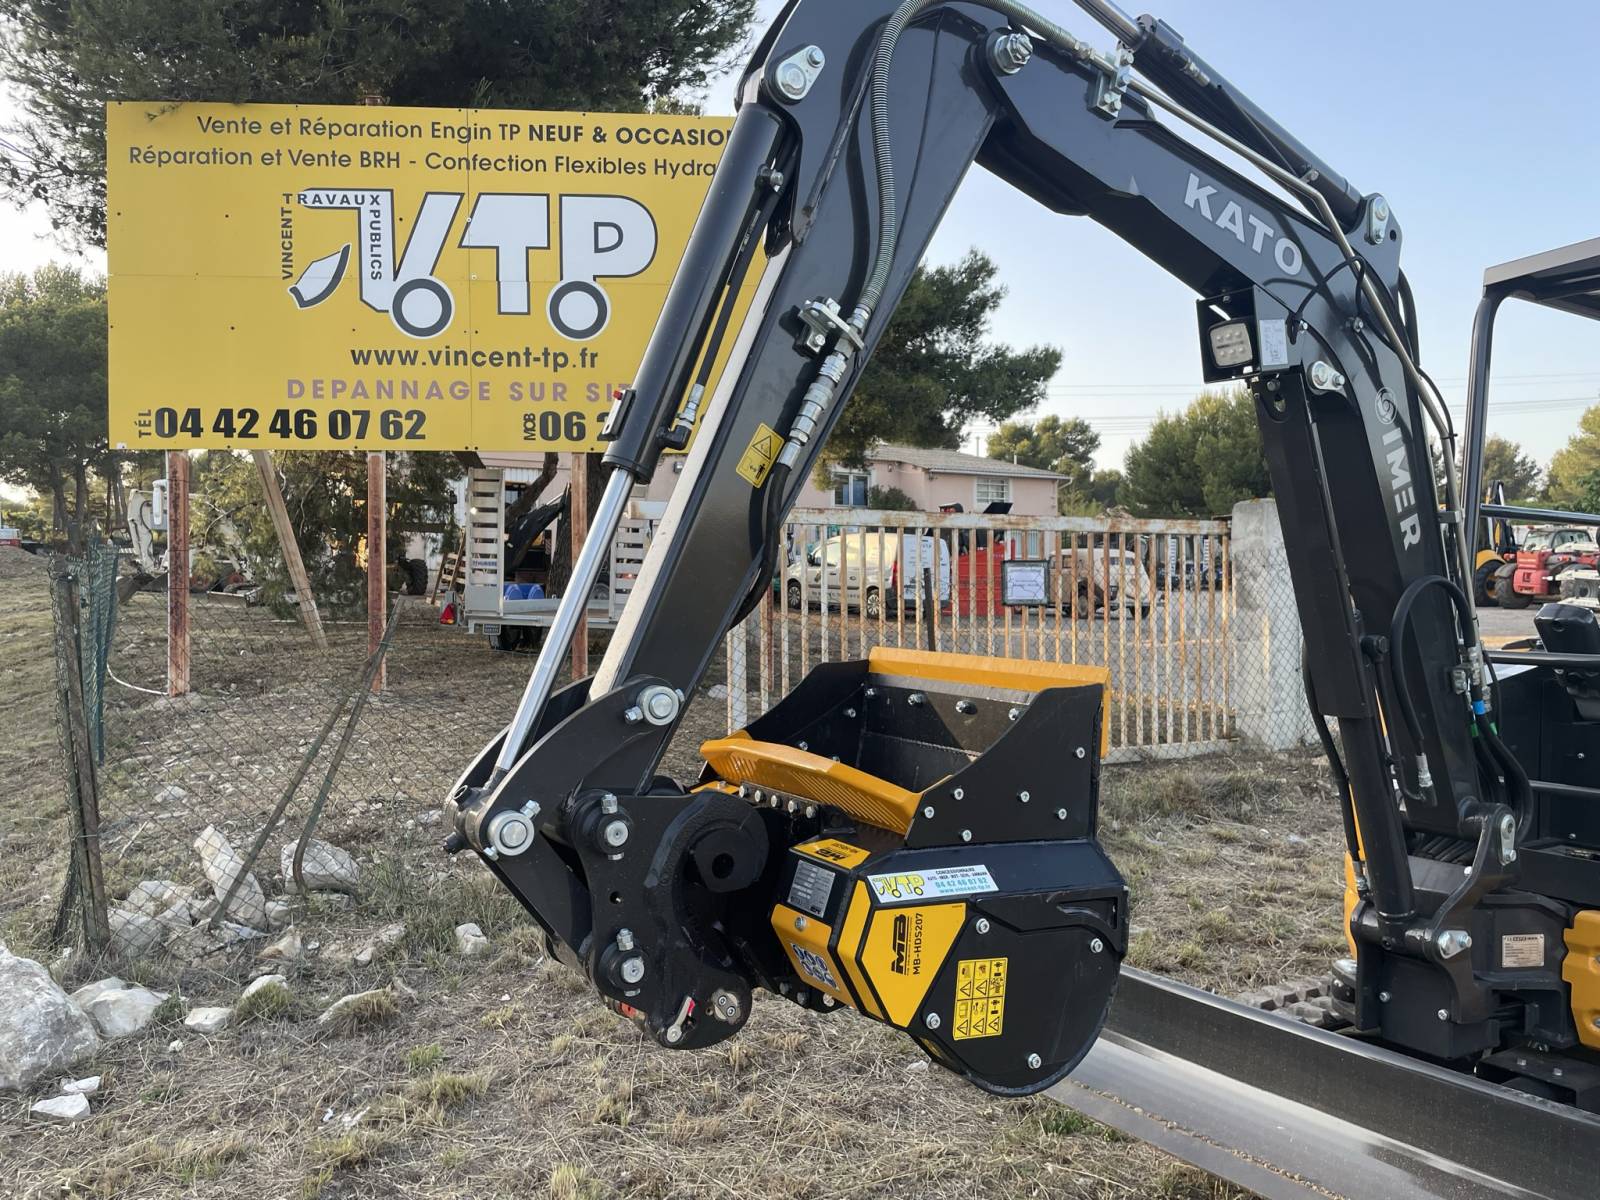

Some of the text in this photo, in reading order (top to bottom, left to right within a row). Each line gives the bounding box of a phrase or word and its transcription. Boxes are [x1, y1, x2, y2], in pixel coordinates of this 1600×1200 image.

[197, 116, 262, 135] Vente
[270, 117, 293, 136] et
[299, 117, 423, 139] Réparation
[431, 121, 492, 144] Engin
[499, 123, 521, 141] TP
[529, 124, 584, 143] NEUF
[592, 126, 607, 143] &
[129, 145, 253, 167] Réparation
[261, 149, 282, 166] et
[287, 149, 352, 168] Vente
[360, 151, 400, 169] BRH
[425, 152, 547, 173] Confection
[555, 156, 647, 176] Flexibles
[283, 192, 381, 207] TRAVAUX
[1183, 172, 1303, 276] KATO
[281, 207, 293, 280] VINCENT
[369, 208, 382, 281] PUBLICS
[350, 345, 599, 373] www.vincent-tp.fr
[287, 379, 491, 402] DEPANNAGE
[509, 381, 568, 402] SUR
[134, 407, 427, 440] TÉL 04 42 46 07 62
[523, 413, 536, 440] MOB
[539, 411, 586, 442] 06
[1382, 427, 1422, 551] IMER
[890, 914, 907, 975] MB
[913, 912, 923, 975] MB-HDS207
